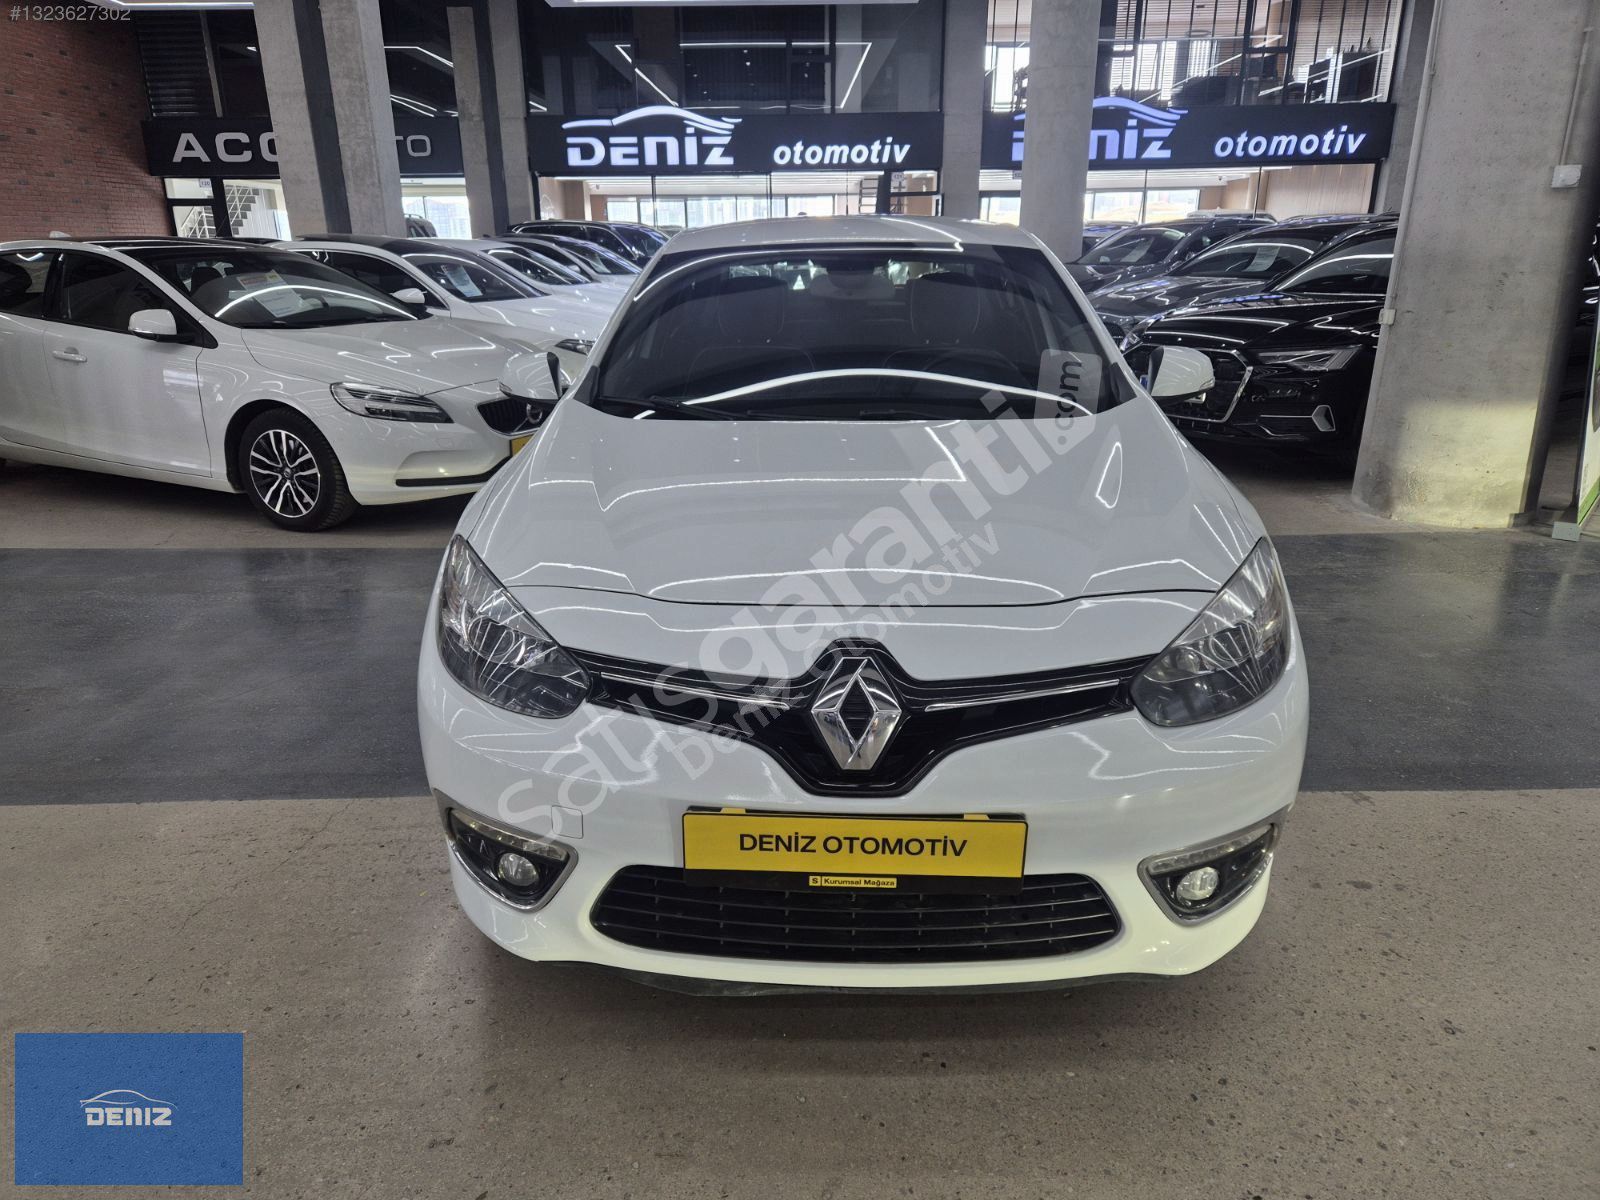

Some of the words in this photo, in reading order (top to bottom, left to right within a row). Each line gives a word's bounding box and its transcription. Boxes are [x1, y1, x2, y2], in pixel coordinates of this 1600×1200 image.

[773, 136, 911, 166] otomotiv
[1012, 119, 1174, 161] NİZ
[1214, 124, 1367, 158] otomotiv
[739, 831, 817, 853] DENİZ
[822, 835, 968, 857] OTOMOTİV
[824, 878, 862, 886] Kurumsal
[863, 879, 895, 887] Mağaza
